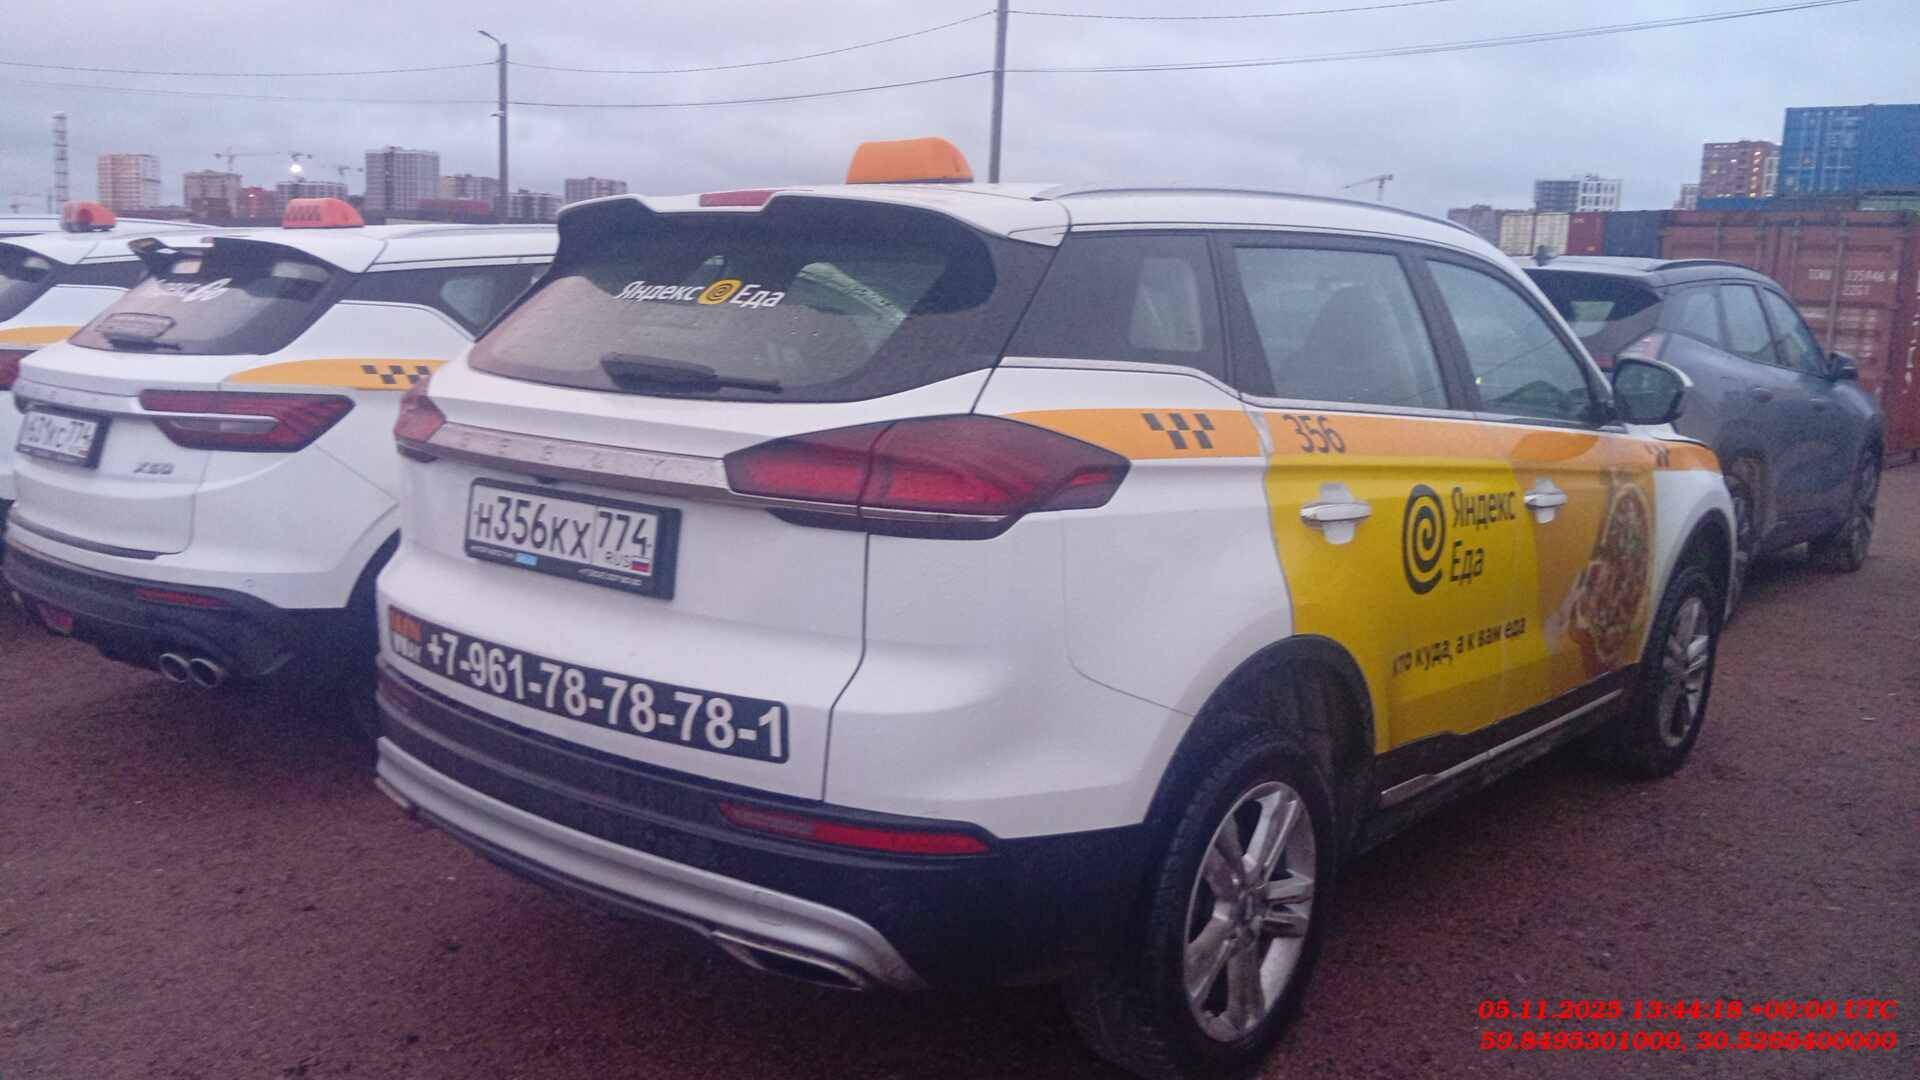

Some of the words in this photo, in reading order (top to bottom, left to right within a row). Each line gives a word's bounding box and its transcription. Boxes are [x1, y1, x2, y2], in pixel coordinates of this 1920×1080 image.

[614, 280, 705, 301] Яндекс
[728, 283, 786, 309] Еда
[1281, 413, 1346, 454] 356
[1451, 486, 1516, 531] Яндекс
[1449, 539, 1485, 586] Еда
[427, 631, 784, 758] +7-961-78-78-78-1
